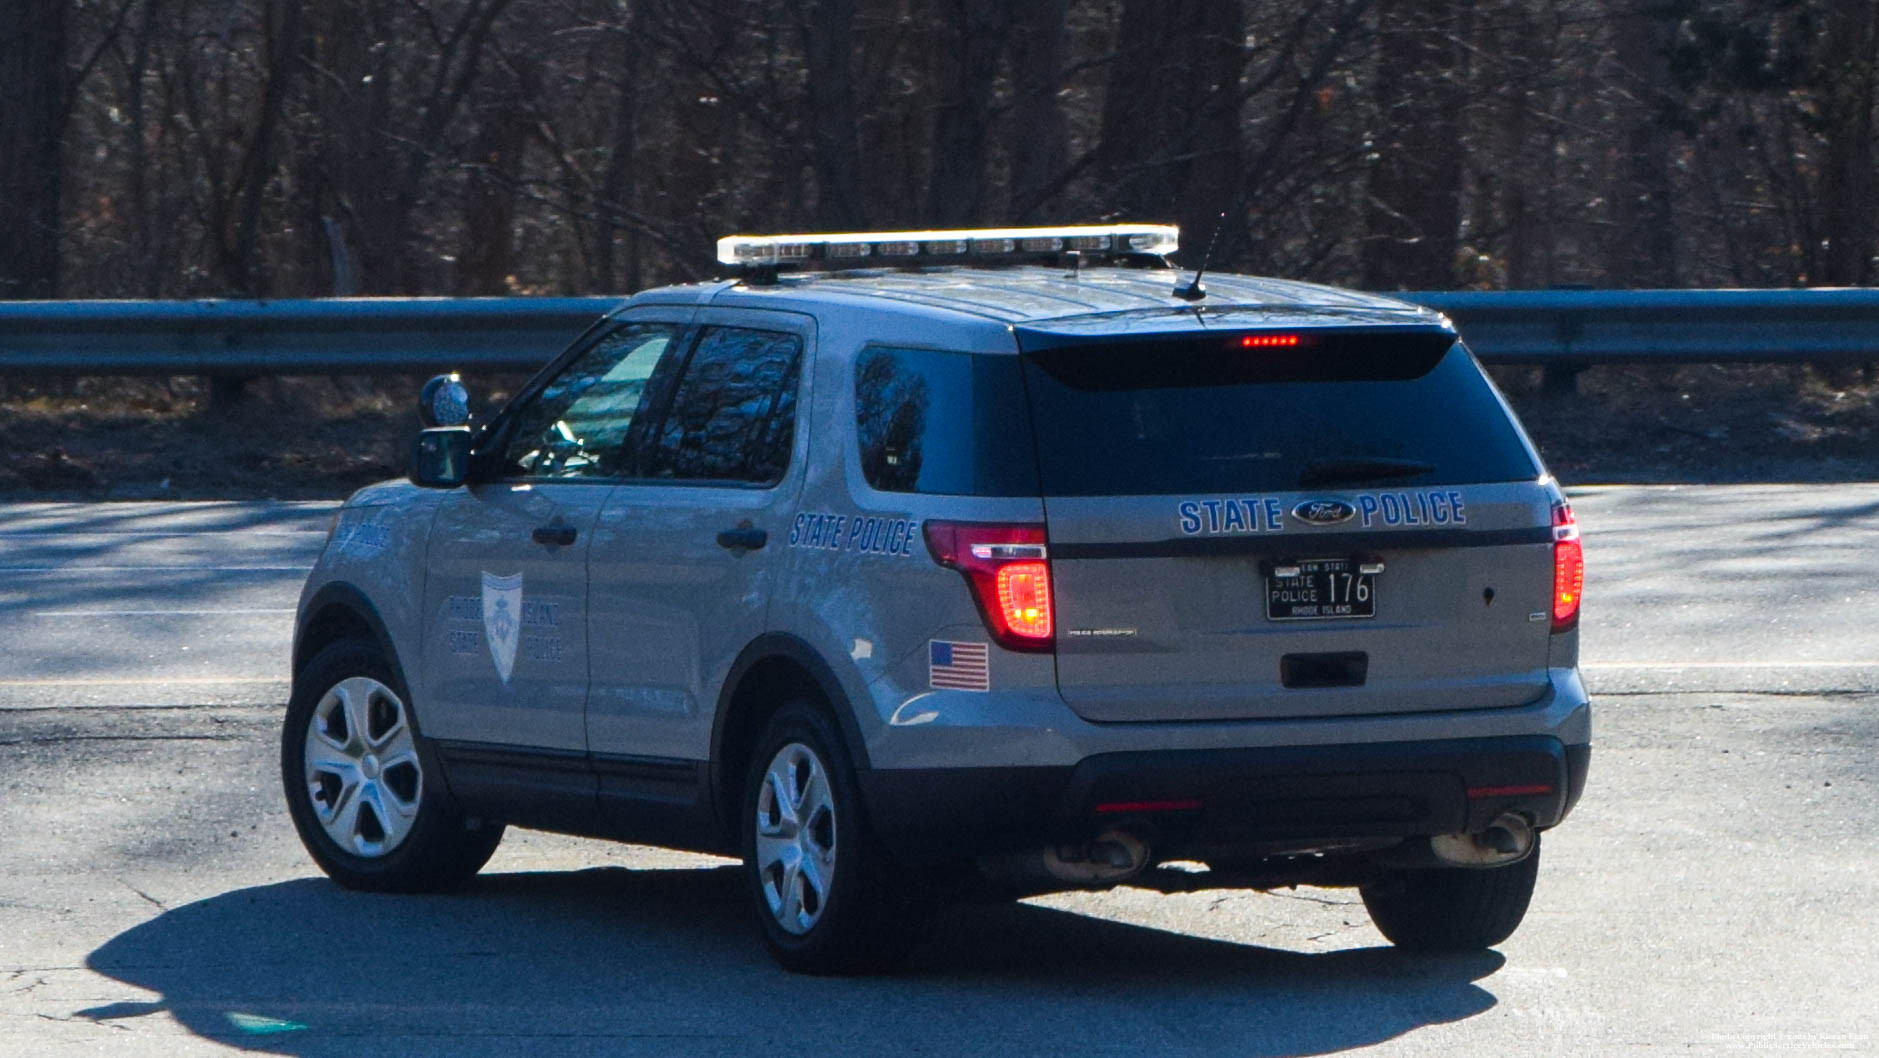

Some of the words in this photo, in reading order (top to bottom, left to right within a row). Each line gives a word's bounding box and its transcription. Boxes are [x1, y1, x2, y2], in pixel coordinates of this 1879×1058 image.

[1179, 498, 1284, 535] STATE
[1360, 492, 1467, 529] POLICE
[789, 512, 847, 551] STATE
[846, 516, 919, 557] POLICE
[1275, 575, 1315, 588] STATE
[1329, 573, 1368, 602] 176
[1272, 590, 1318, 602] POLICE
[1292, 605, 1319, 616] RHODE
[1322, 604, 1352, 615] ISLAND
